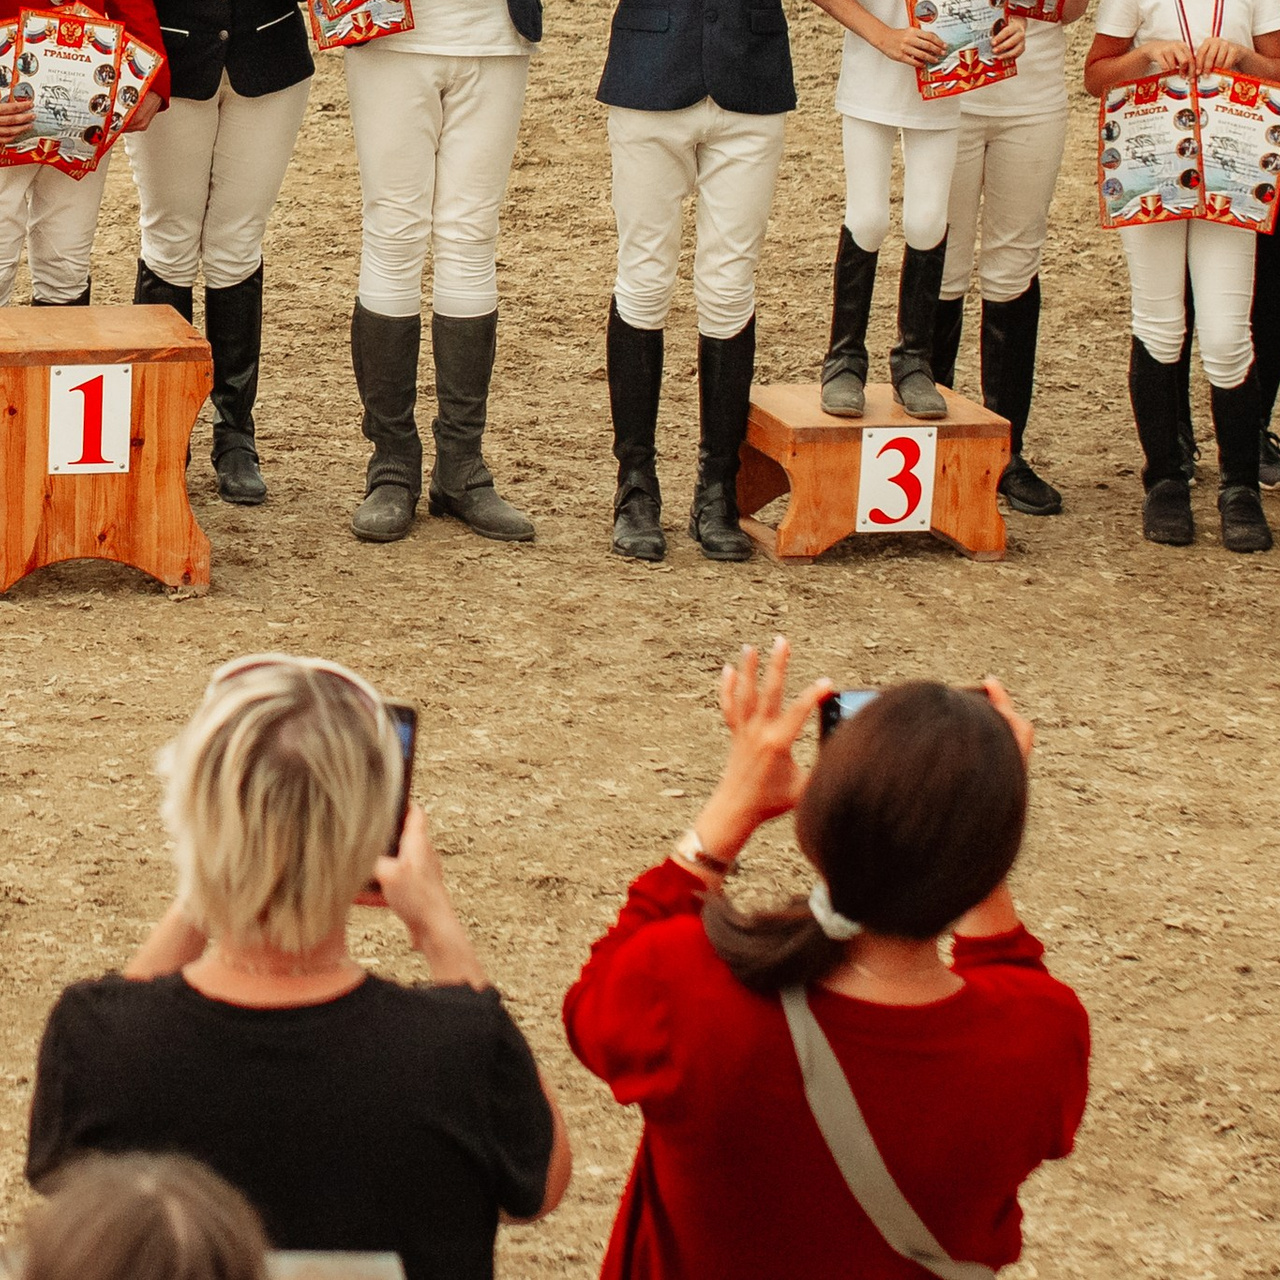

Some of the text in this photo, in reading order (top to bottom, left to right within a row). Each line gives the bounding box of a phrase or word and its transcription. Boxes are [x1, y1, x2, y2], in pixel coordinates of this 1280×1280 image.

[43, 49, 92, 63] ГРАМОТА
[1124, 105, 1169, 119] ГРАМОТА
[1214, 105, 1264, 122] ГРАМОТА
[67, 375, 114, 465] 1
[869, 436, 922, 525] 3
